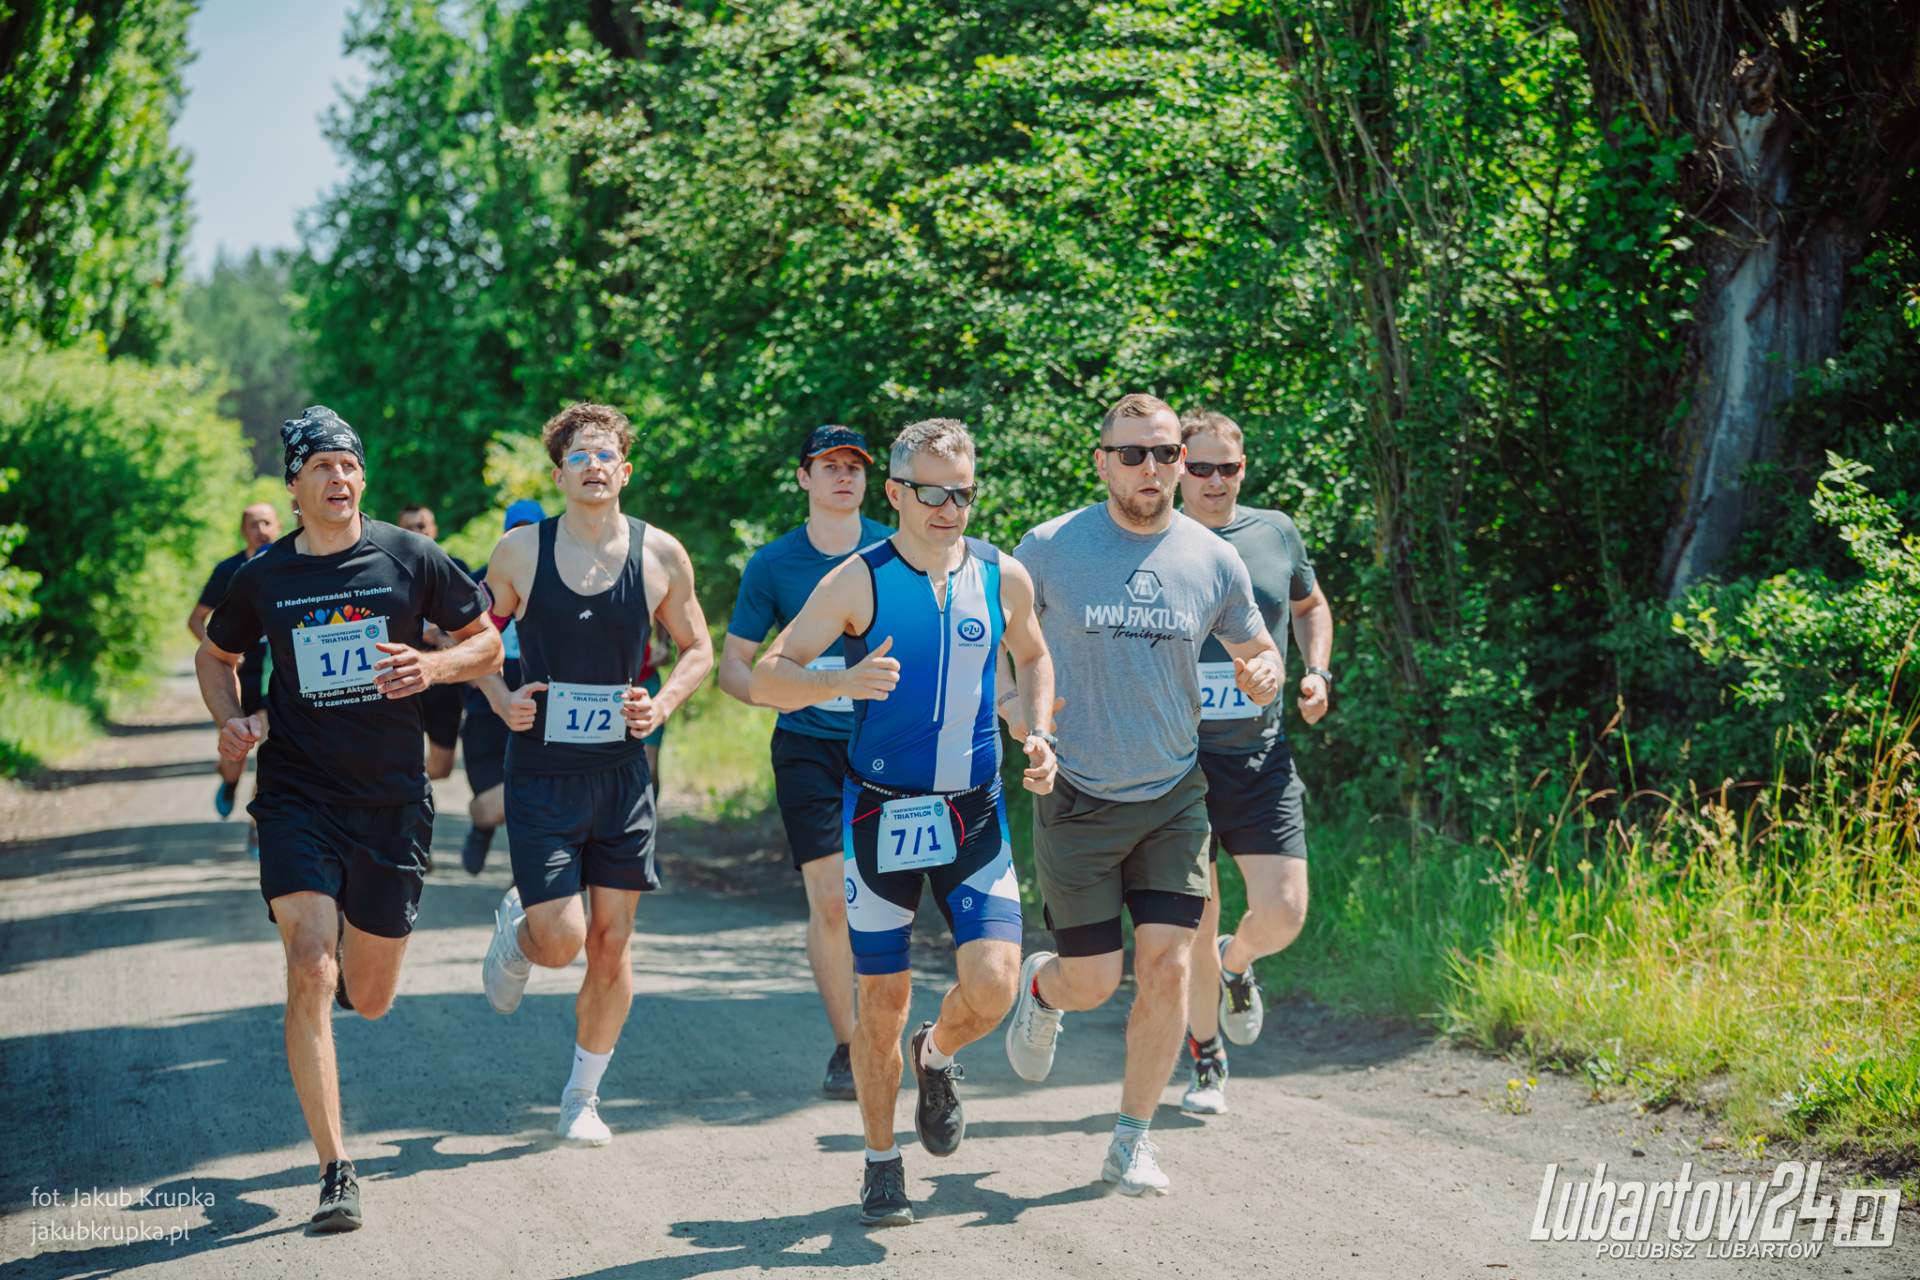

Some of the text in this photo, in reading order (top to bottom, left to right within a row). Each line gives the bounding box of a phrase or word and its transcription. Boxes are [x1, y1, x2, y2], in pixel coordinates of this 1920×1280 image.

[285, 591, 351, 606] Nadwieprzański
[354, 586, 392, 597] Triathlon
[321, 633, 361, 645] TRIATHLON
[963, 624, 980, 636] PZU
[320, 647, 372, 677] 1/1
[325, 697, 361, 707] czerwca
[362, 693, 383, 702] 2025
[1200, 686, 1246, 709] 2/1
[566, 708, 612, 732] 1/2
[893, 810, 932, 820] TRIATHLON
[891, 825, 941, 856] 7/1
